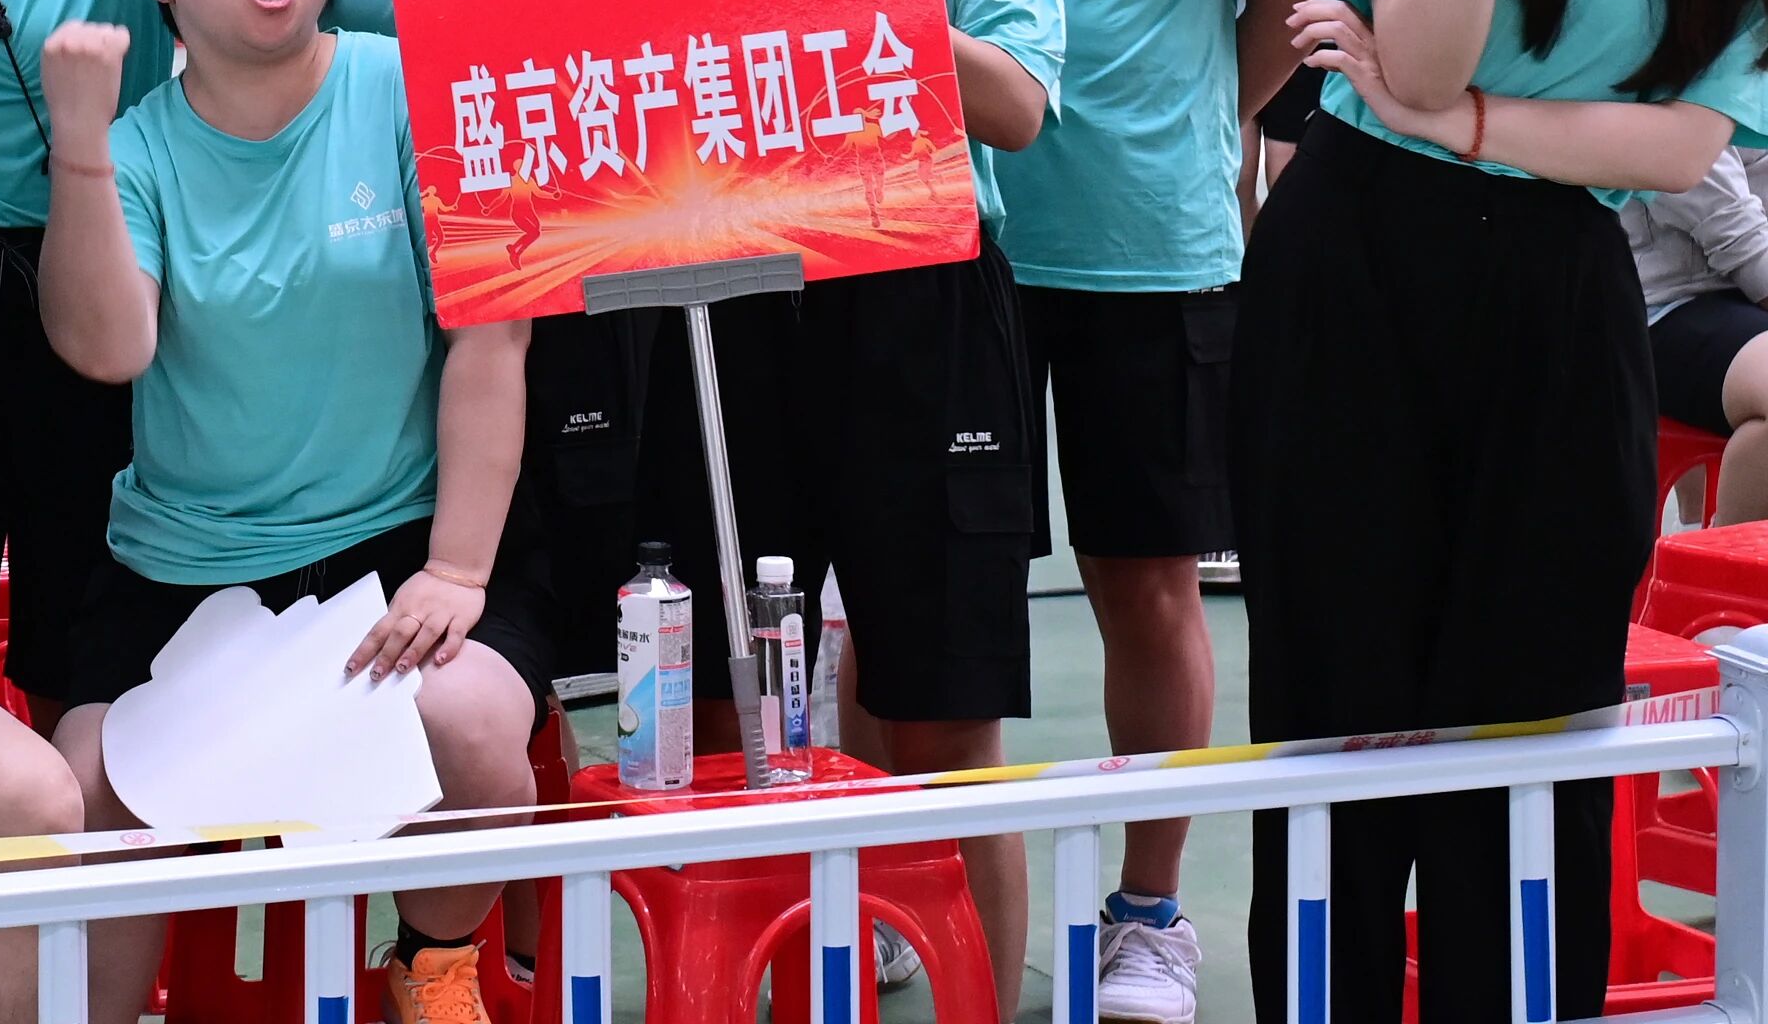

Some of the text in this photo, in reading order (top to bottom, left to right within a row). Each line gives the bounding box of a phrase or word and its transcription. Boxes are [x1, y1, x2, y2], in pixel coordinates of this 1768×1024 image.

[450, 11, 920, 195] 盛京资产集团工会
[328, 208, 404, 238] 盛京大东城
[570, 411, 603, 424] KELME
[956, 432, 992, 443] KELME
